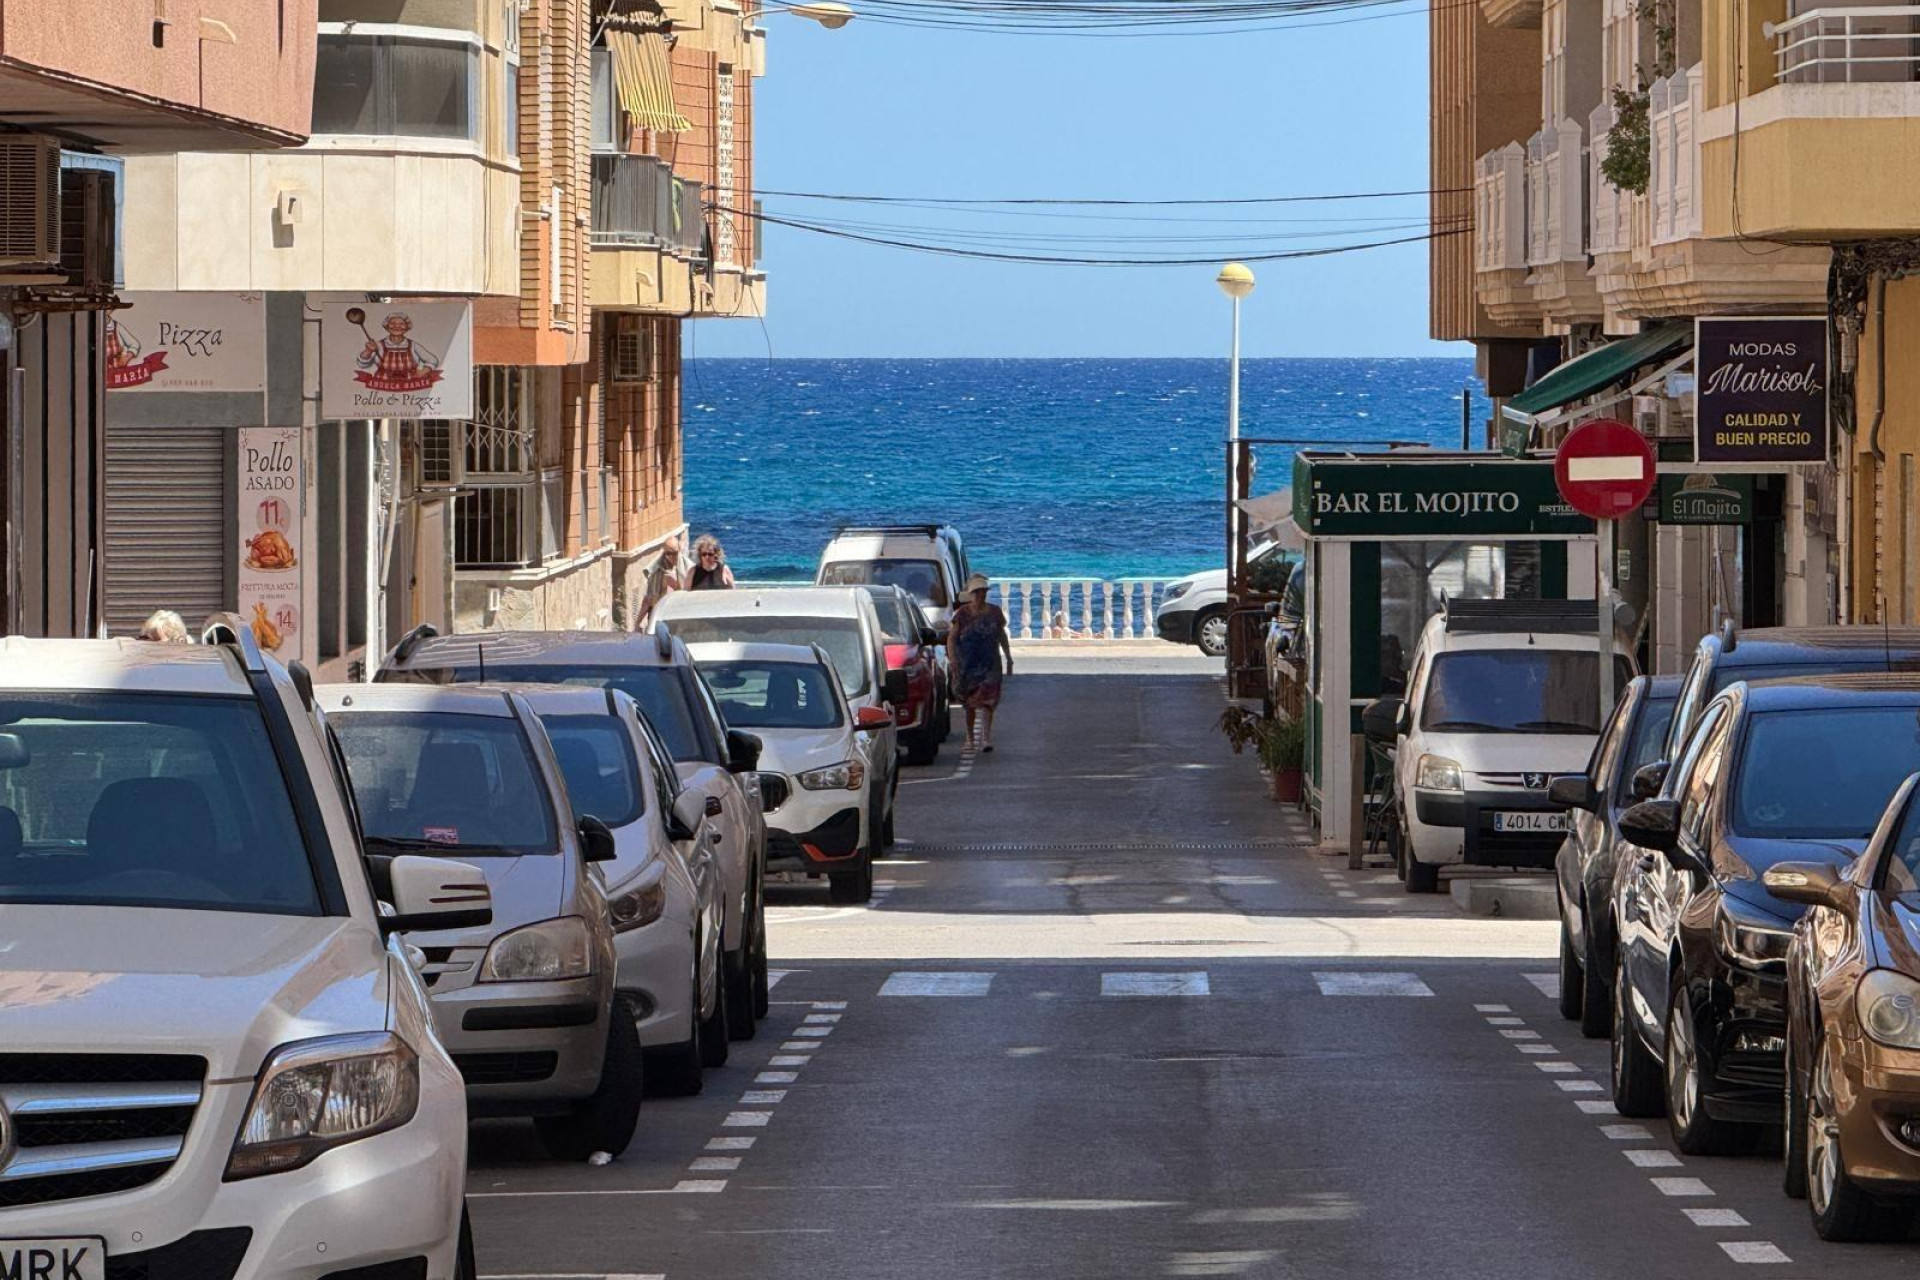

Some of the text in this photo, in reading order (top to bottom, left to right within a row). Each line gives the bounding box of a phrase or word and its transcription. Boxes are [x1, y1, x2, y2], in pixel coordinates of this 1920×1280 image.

[158, 322, 223, 357] Pizza
[1729, 343, 1797, 356] MODAS
[1703, 362, 1822, 395] Marisol
[354, 391, 441, 411] Pollo & Pizza
[1725, 413, 1802, 426] CALIDAD Y
[1716, 432, 1811, 446] BUEN PRECIO
[246, 441, 293, 472] Pollo
[246, 476, 295, 491] ASADO
[1316, 491, 1520, 518] BAR EL MOJITO
[1673, 499, 1741, 520] El Mojito
[1506, 814, 1541, 829] 4014
[0, 1247, 83, 1280] MRK
